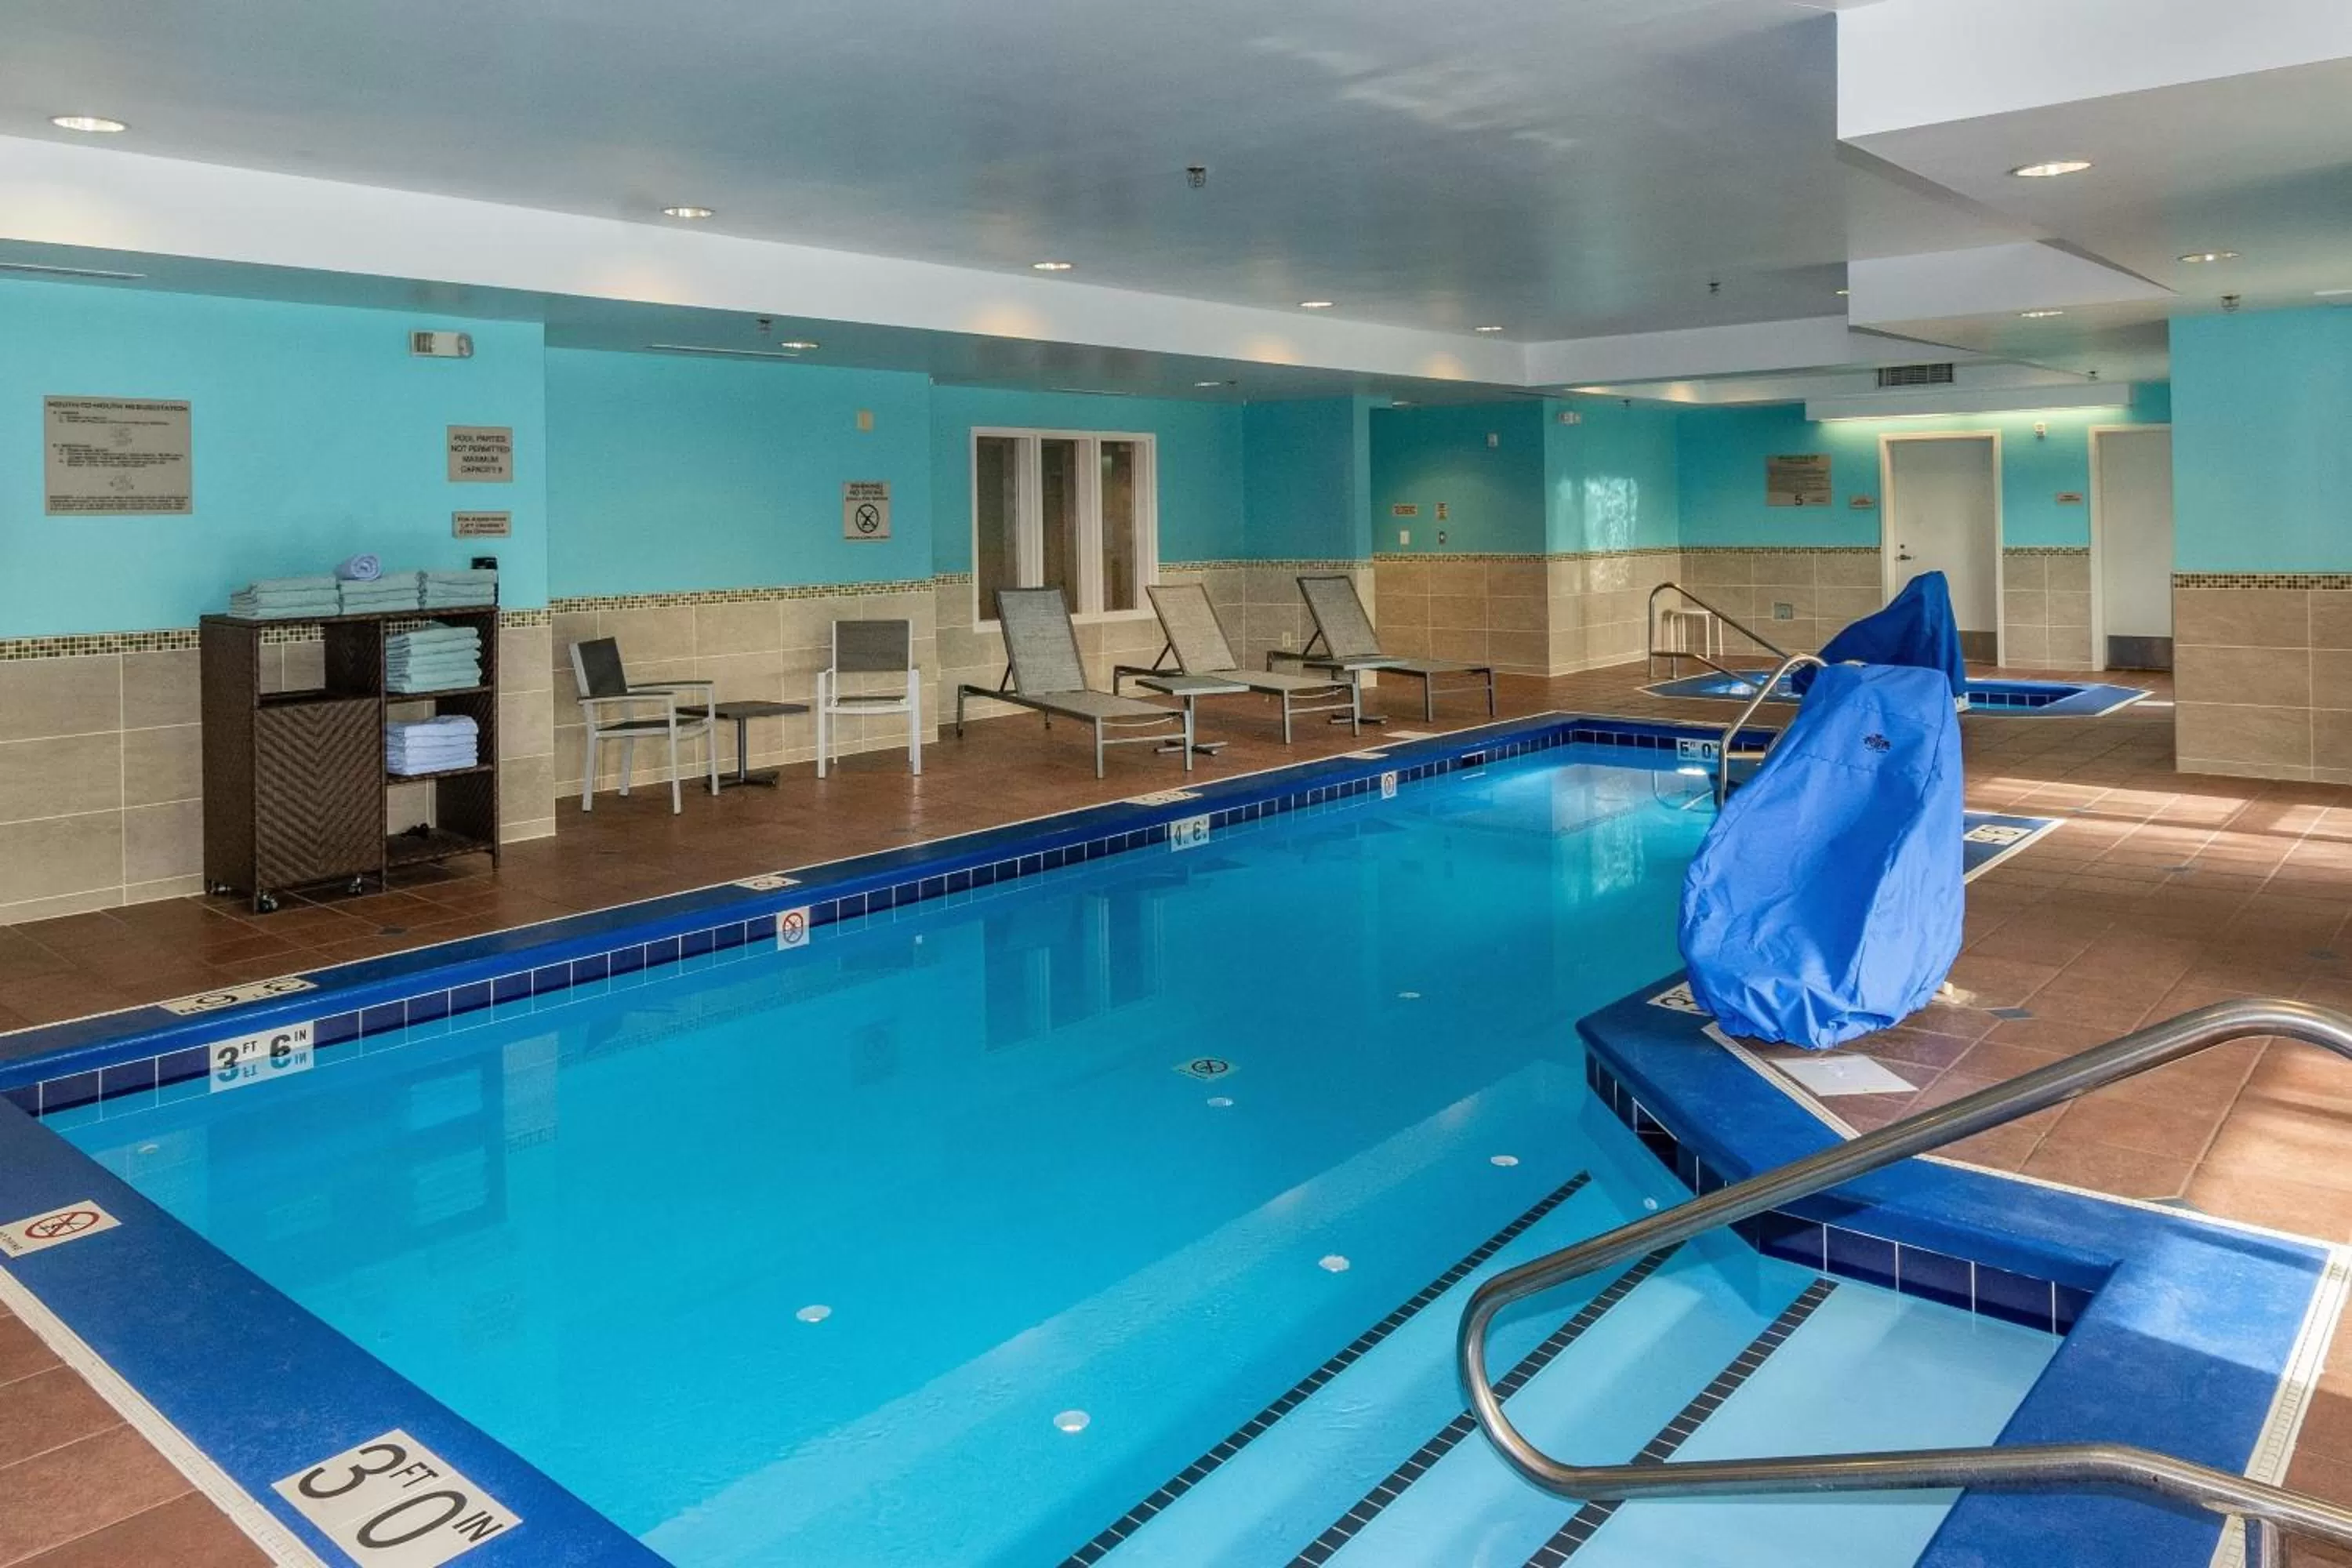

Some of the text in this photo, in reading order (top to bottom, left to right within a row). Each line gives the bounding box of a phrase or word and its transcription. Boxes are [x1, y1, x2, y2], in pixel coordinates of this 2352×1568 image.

[468, 445, 510, 453] PERMITTED
[1702, 742, 1711, 759] 0
[217, 1029, 307, 1079] 3 FT 6 IN
[298, 1443, 439, 1500] 3 FT
[356, 1490, 503, 1548] 0 IN
